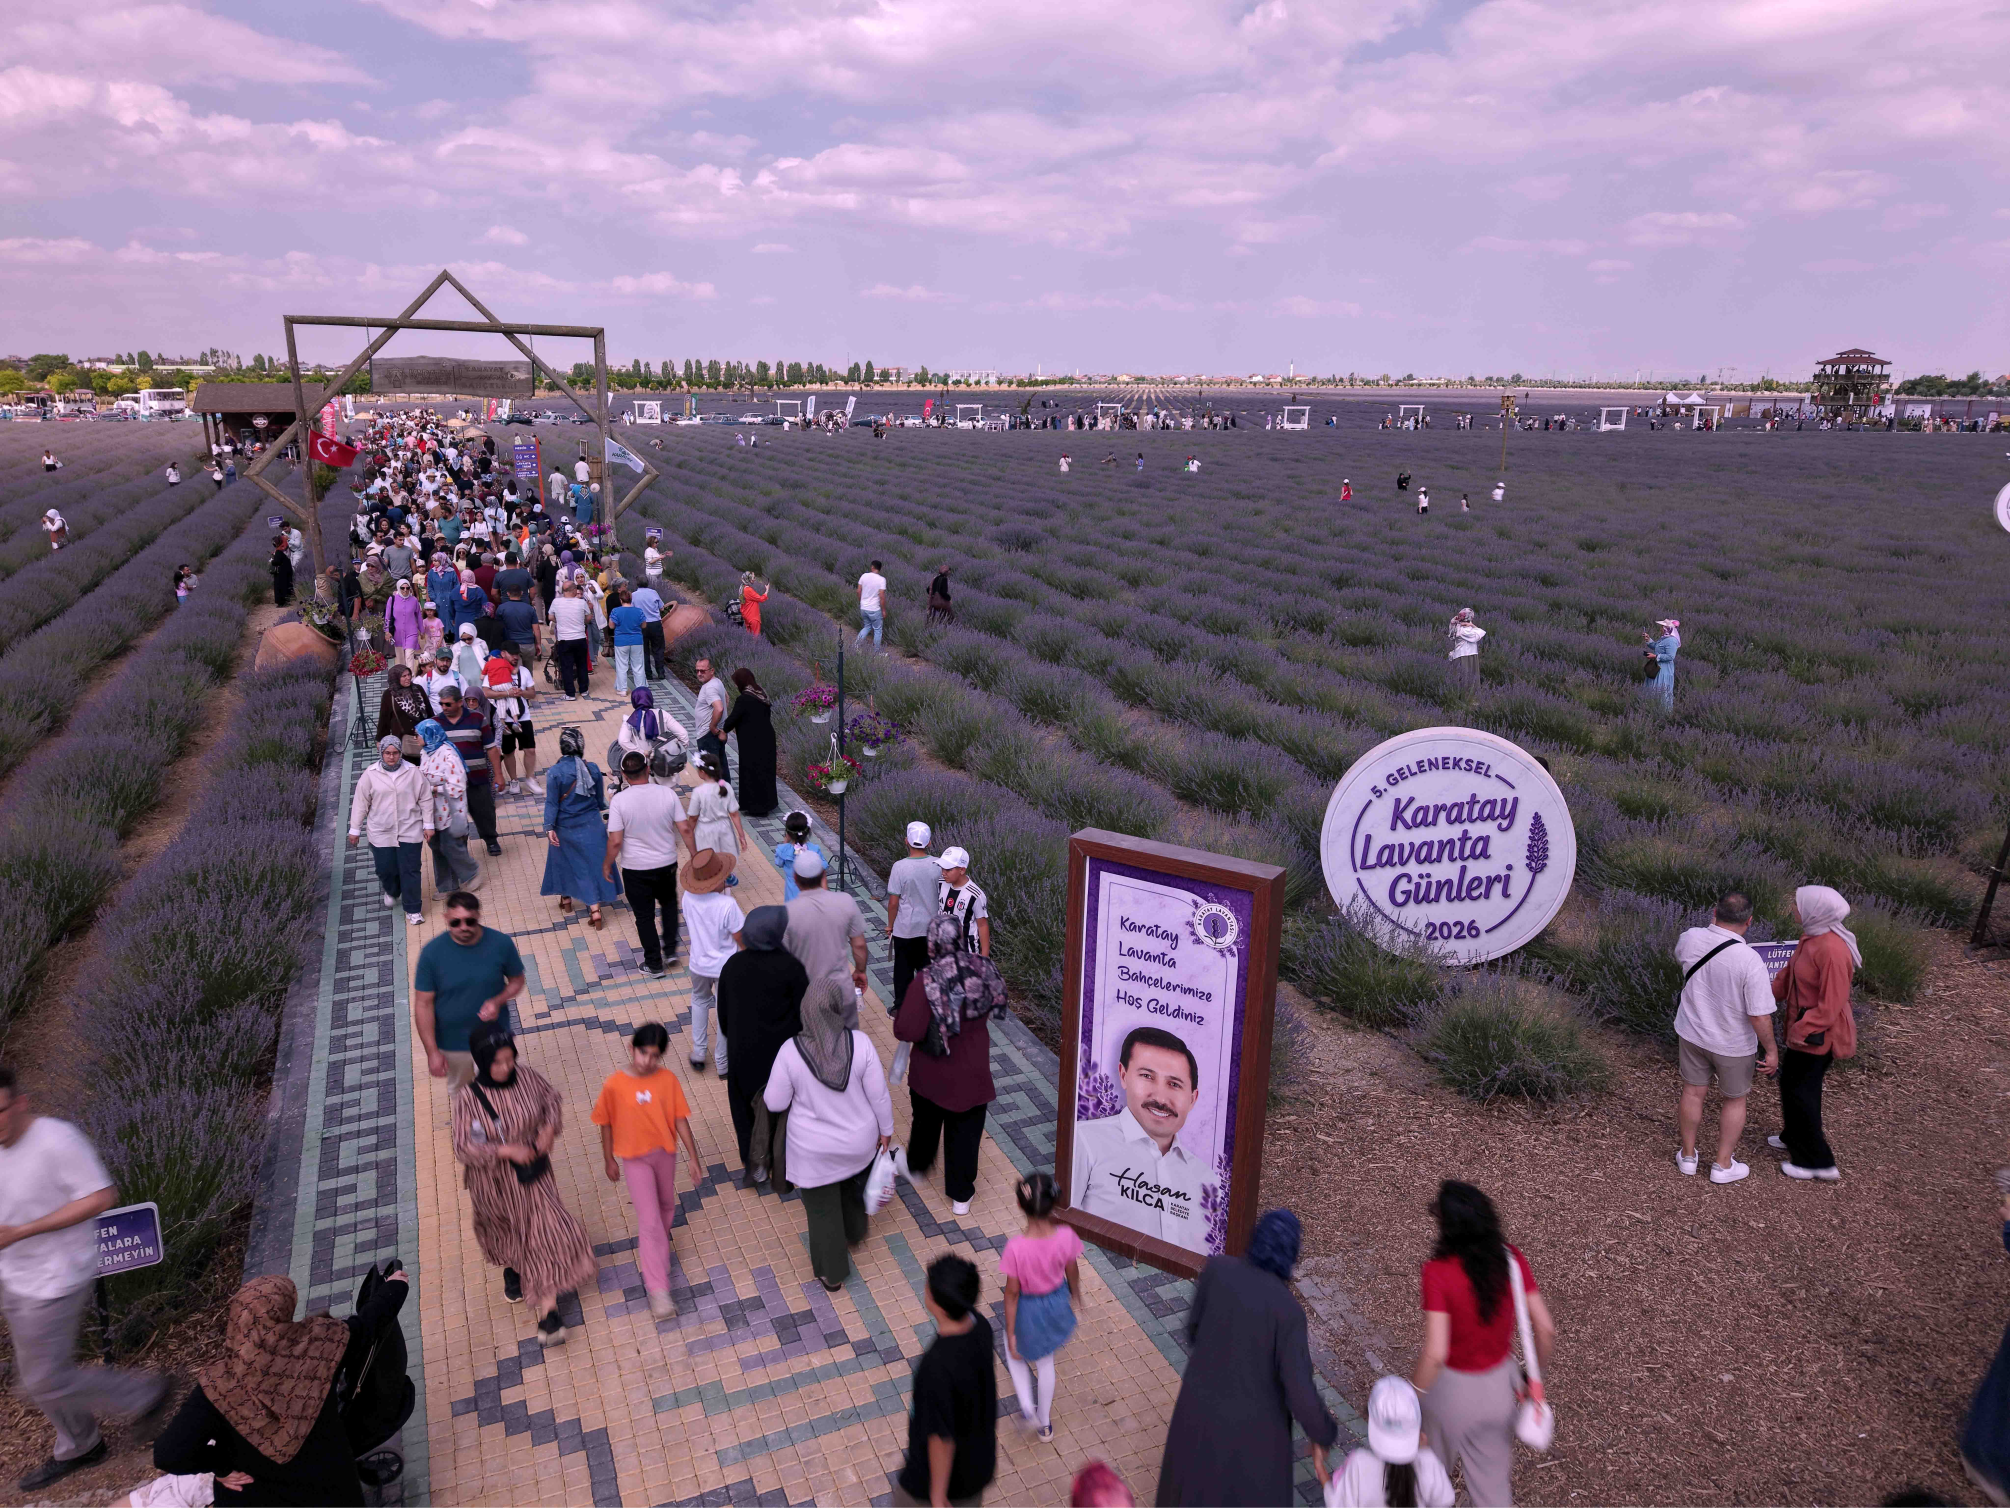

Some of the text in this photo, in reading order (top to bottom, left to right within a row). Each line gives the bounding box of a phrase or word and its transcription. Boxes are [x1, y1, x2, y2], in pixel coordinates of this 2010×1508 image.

[1370, 756, 1492, 799] 5. GELENEKSEL
[1389, 792, 1519, 832] Karatay
[1359, 828, 1491, 870] Lavanta
[1388, 864, 1513, 907] Günleri
[1120, 916, 1179, 950] Karatay
[1424, 919, 1480, 941] 2026
[1119, 941, 1176, 969] Lavanta
[1117, 965, 1213, 1002] Bahçelerimize
[1116, 989, 1205, 1025] Hoş Geldiniz
[1109, 1167, 1191, 1202] Hasan
[1120, 1184, 1165, 1211] KILCA
[97, 1246, 154, 1267] ERMEYİN
